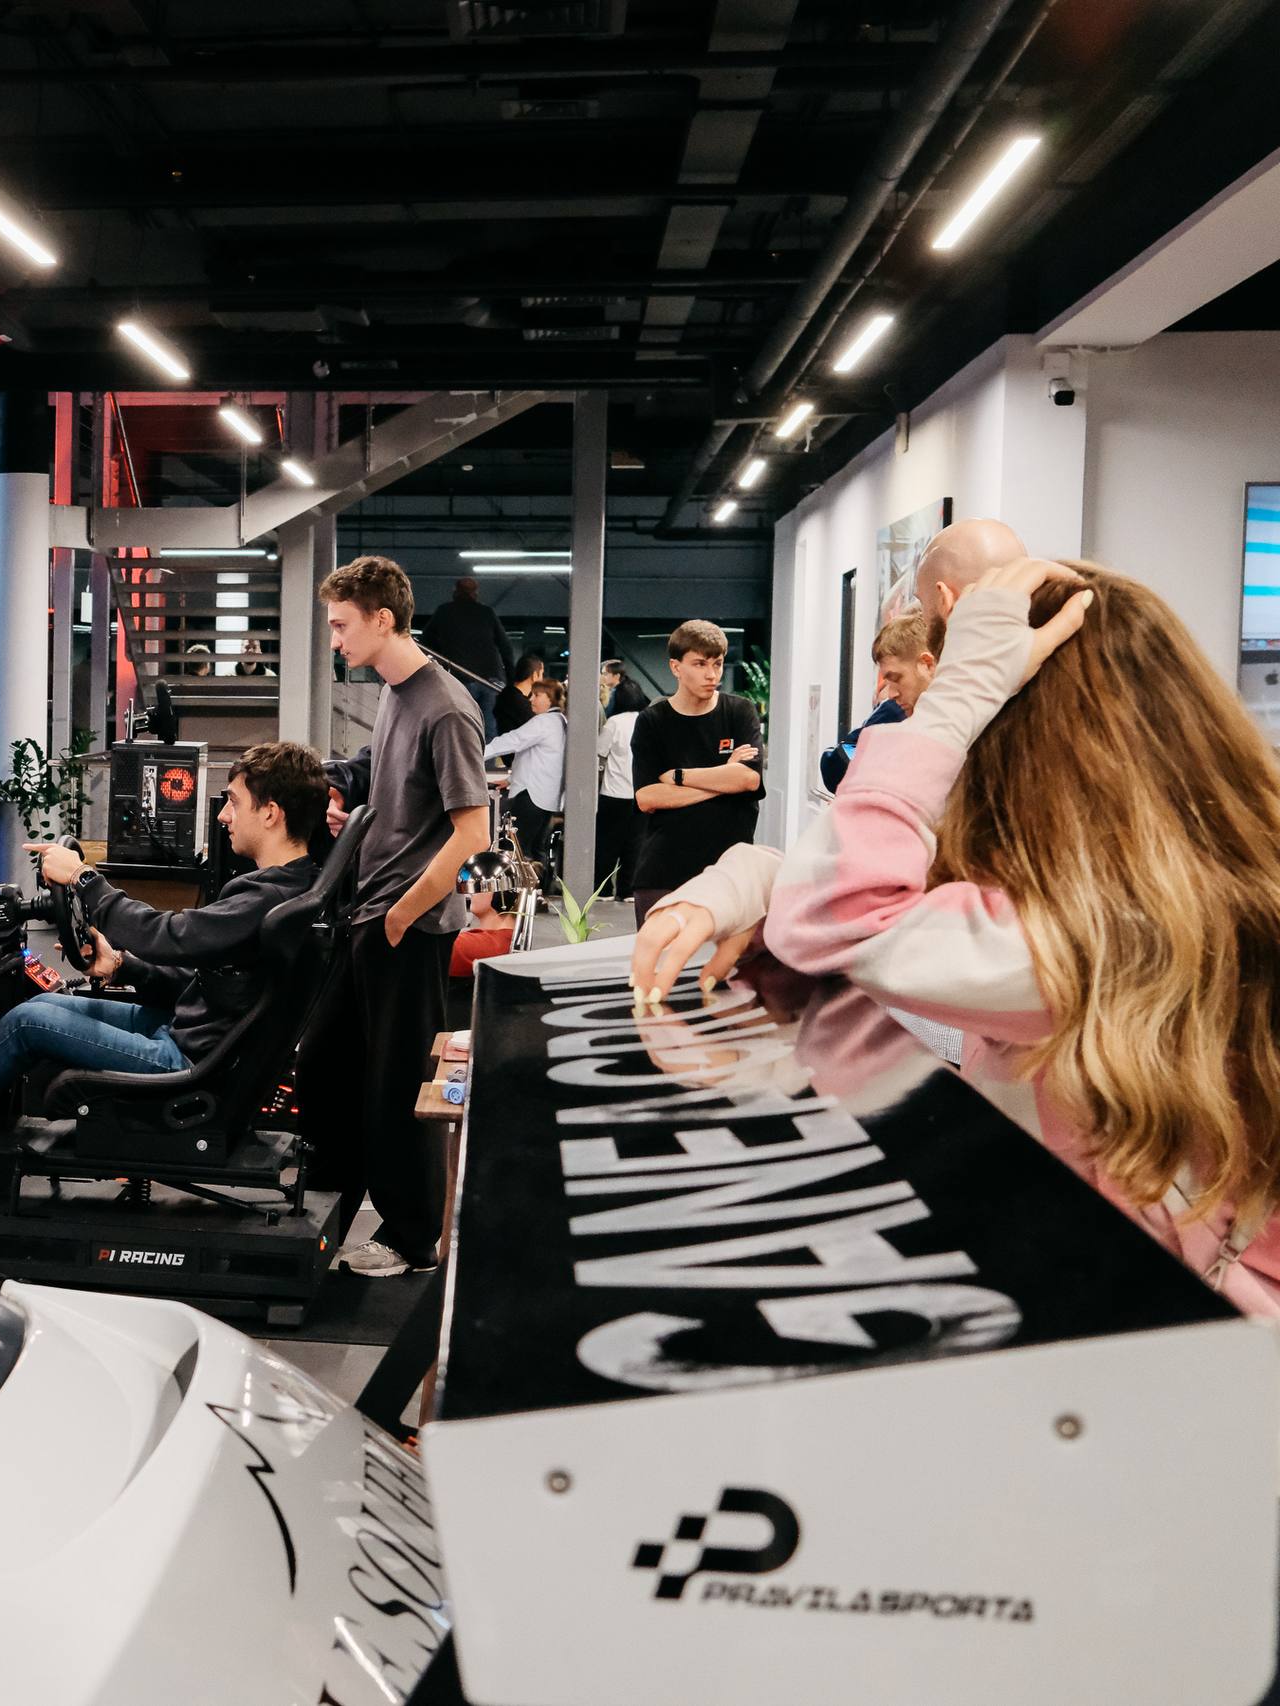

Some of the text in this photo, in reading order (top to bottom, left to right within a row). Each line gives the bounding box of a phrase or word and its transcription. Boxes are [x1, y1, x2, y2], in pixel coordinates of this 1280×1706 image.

[98, 1248, 185, 1266] PI RACING
[702, 1580, 1036, 1624] PRAVILASPORTA
